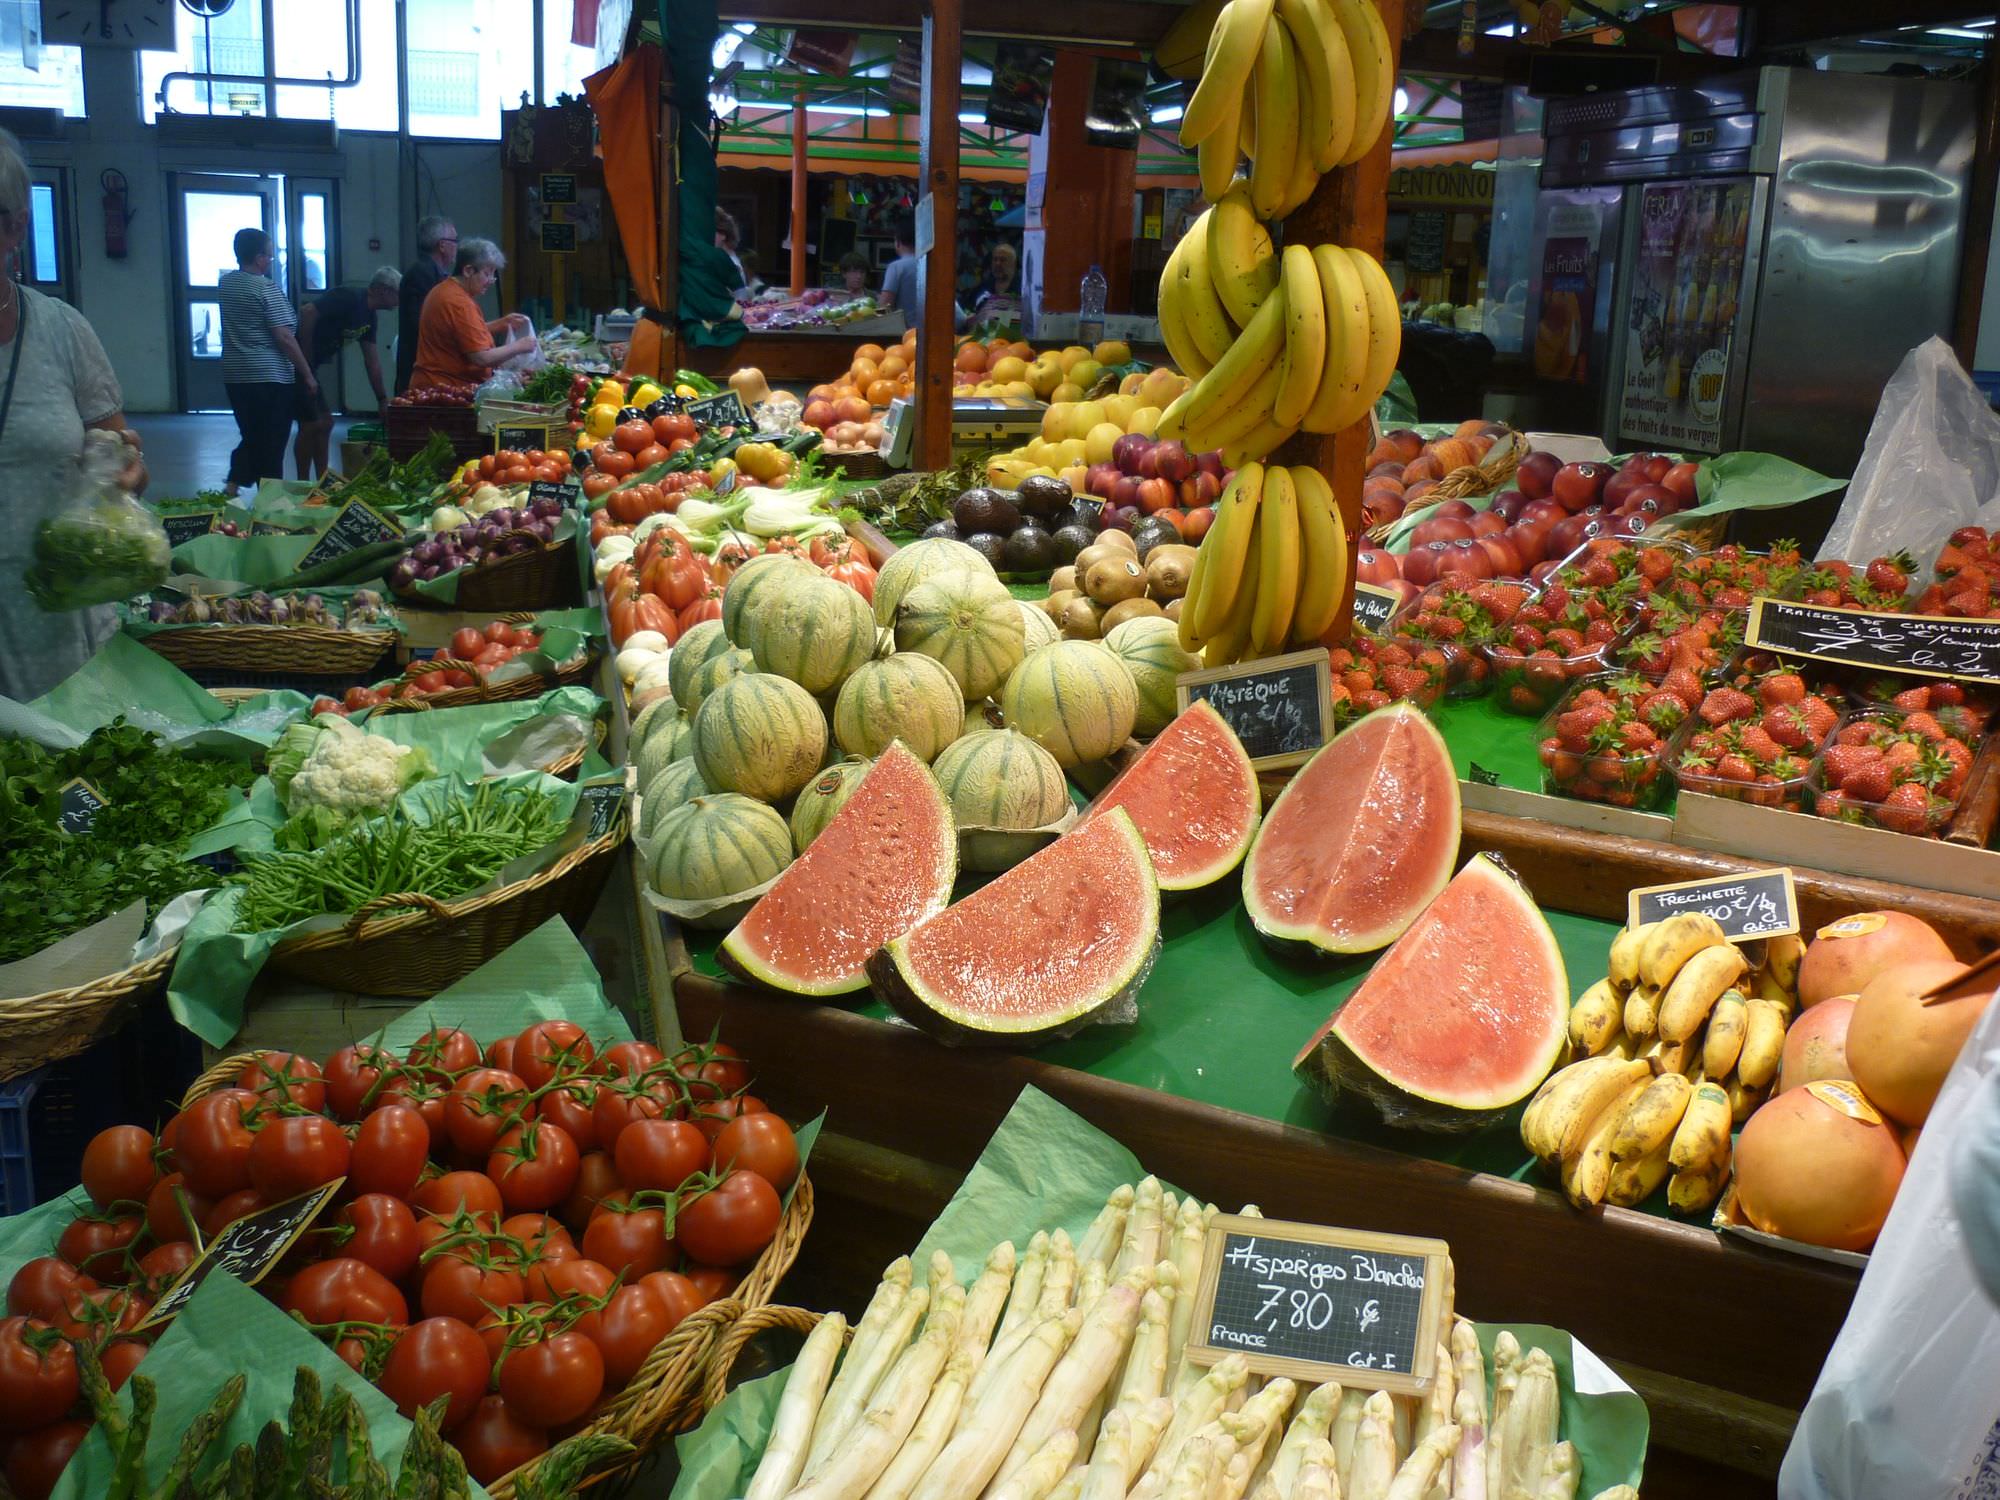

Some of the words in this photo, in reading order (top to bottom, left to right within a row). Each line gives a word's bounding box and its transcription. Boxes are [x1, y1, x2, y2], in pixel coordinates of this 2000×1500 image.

[1777, 604, 1841, 622] FRAISES
[1860, 617, 1882, 627] DE
[1254, 1283, 1334, 1332] 7,80
[1211, 1324, 1268, 1348] France
